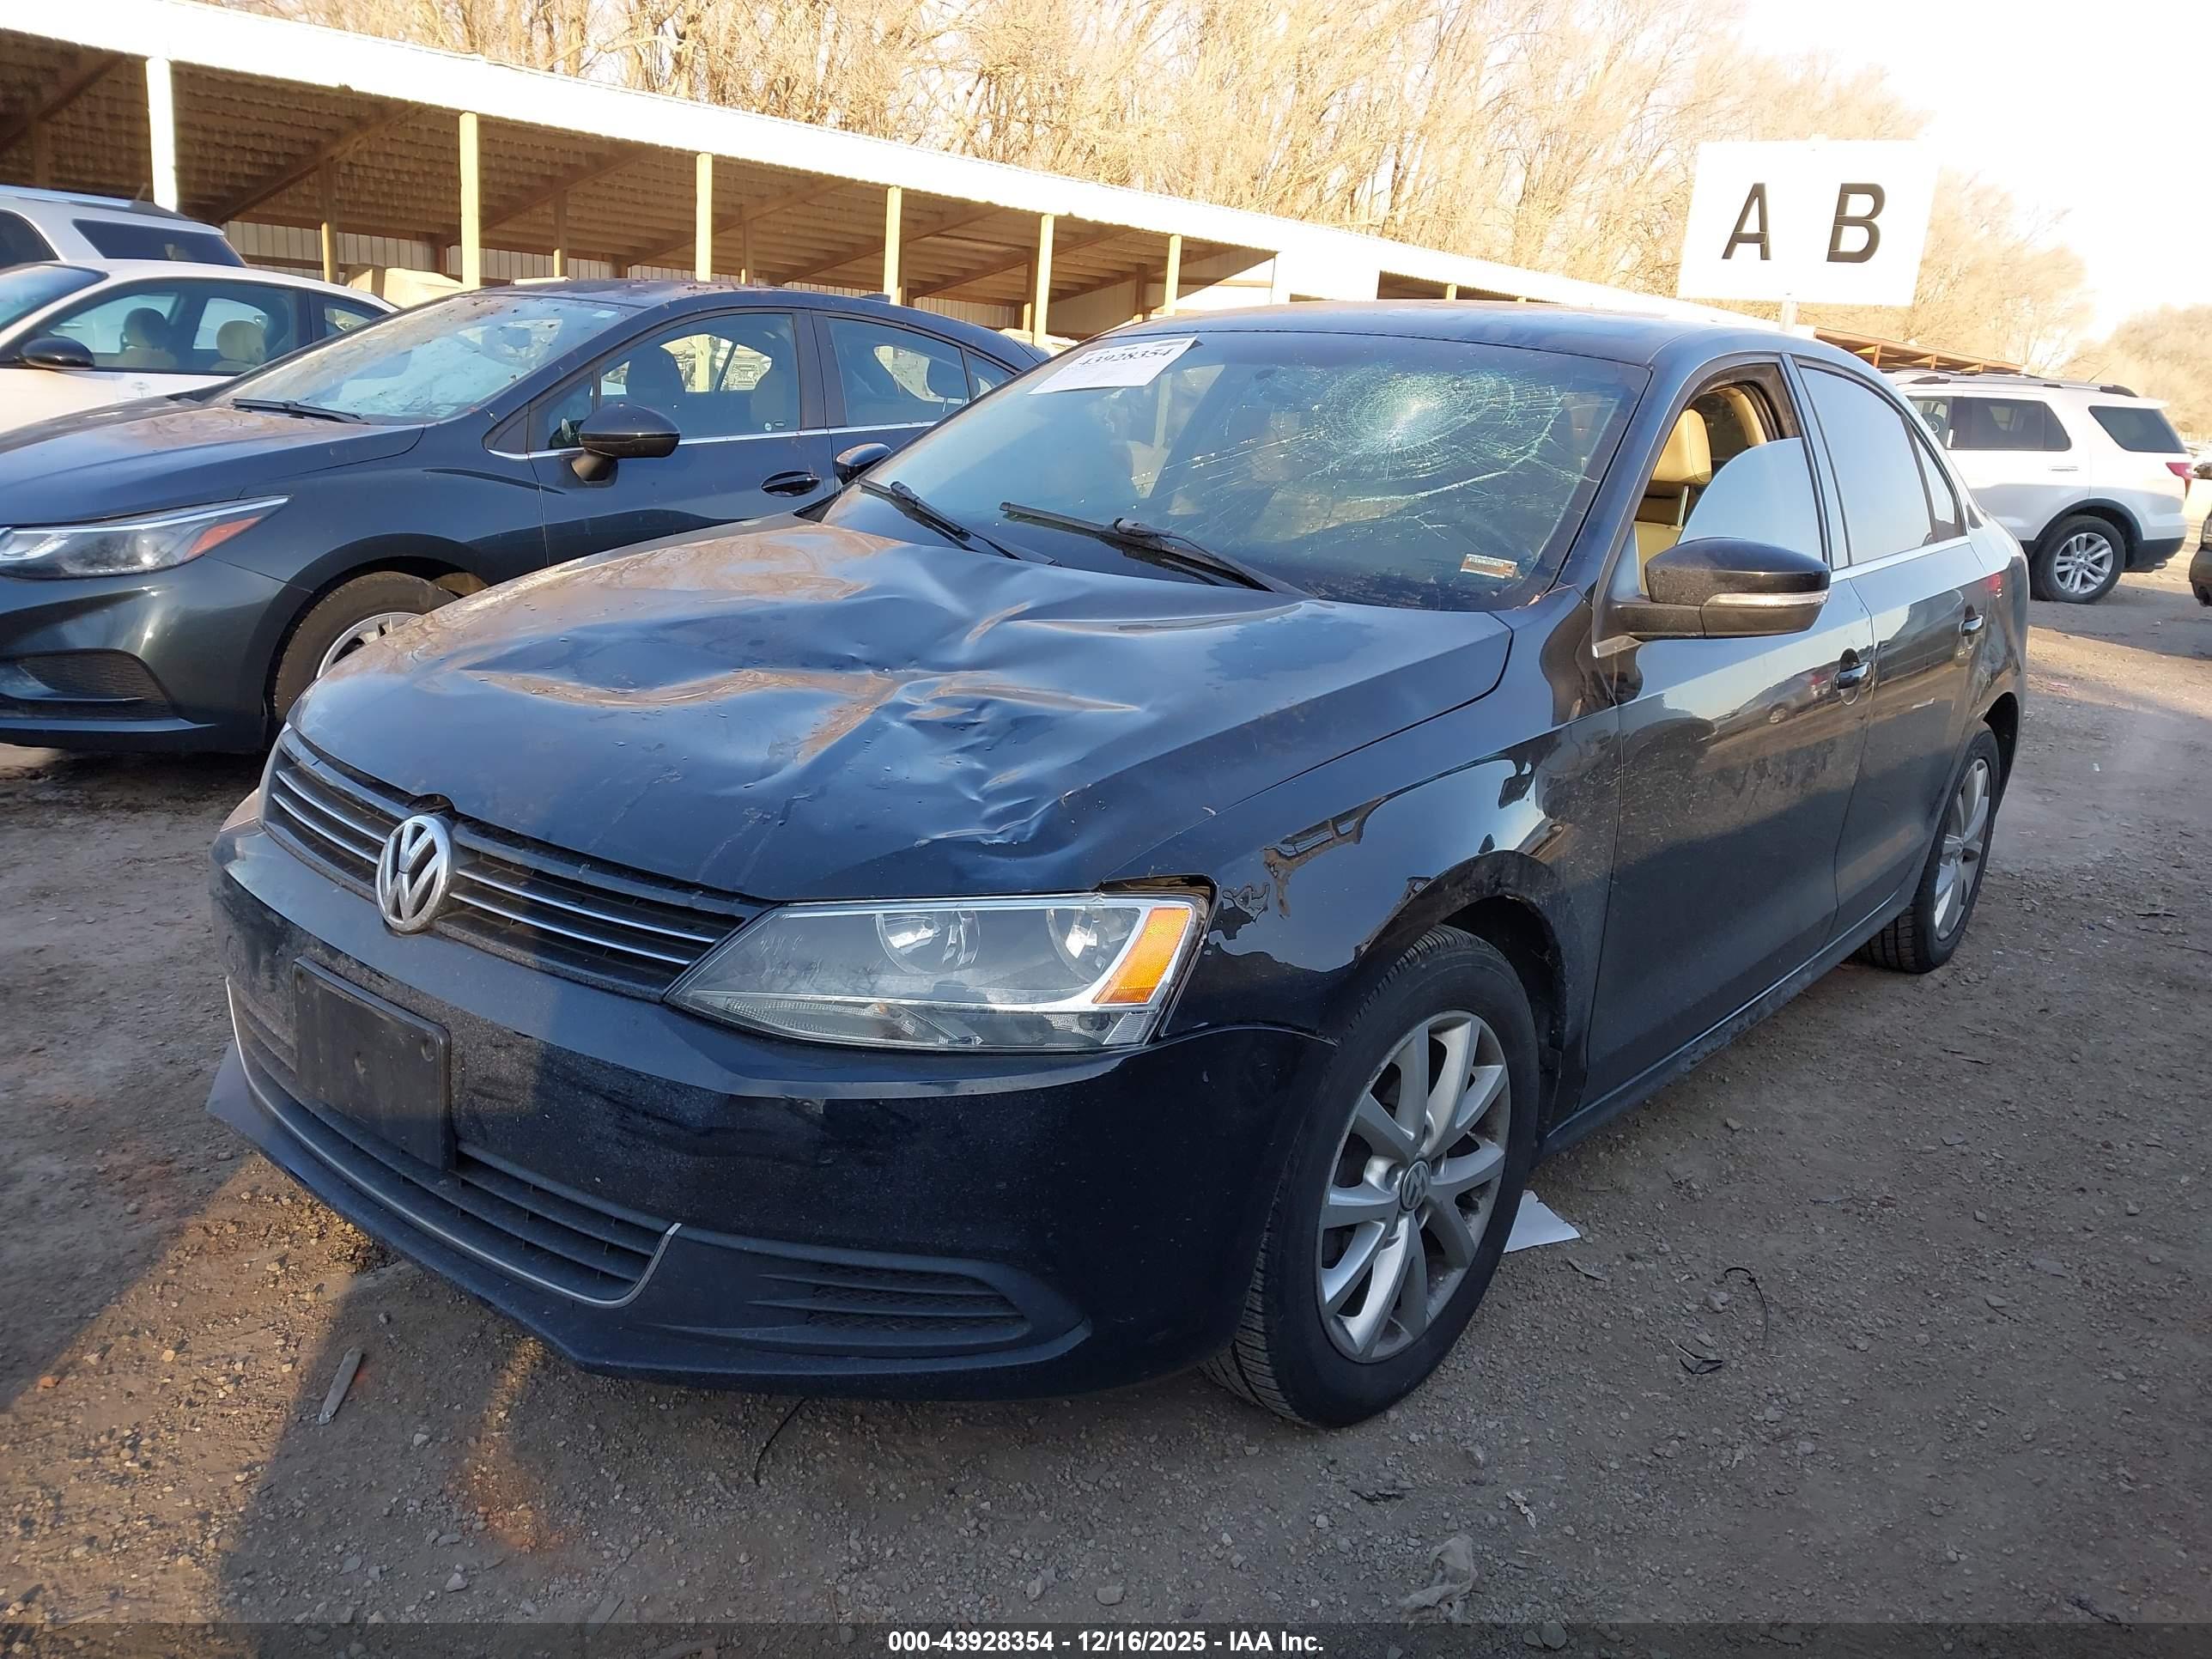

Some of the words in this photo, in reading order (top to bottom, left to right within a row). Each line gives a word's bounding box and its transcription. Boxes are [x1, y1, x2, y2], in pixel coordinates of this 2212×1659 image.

[1721, 183, 1771, 261] A
[1826, 183, 1887, 264] B
[1079, 347, 1176, 366] 43928354
